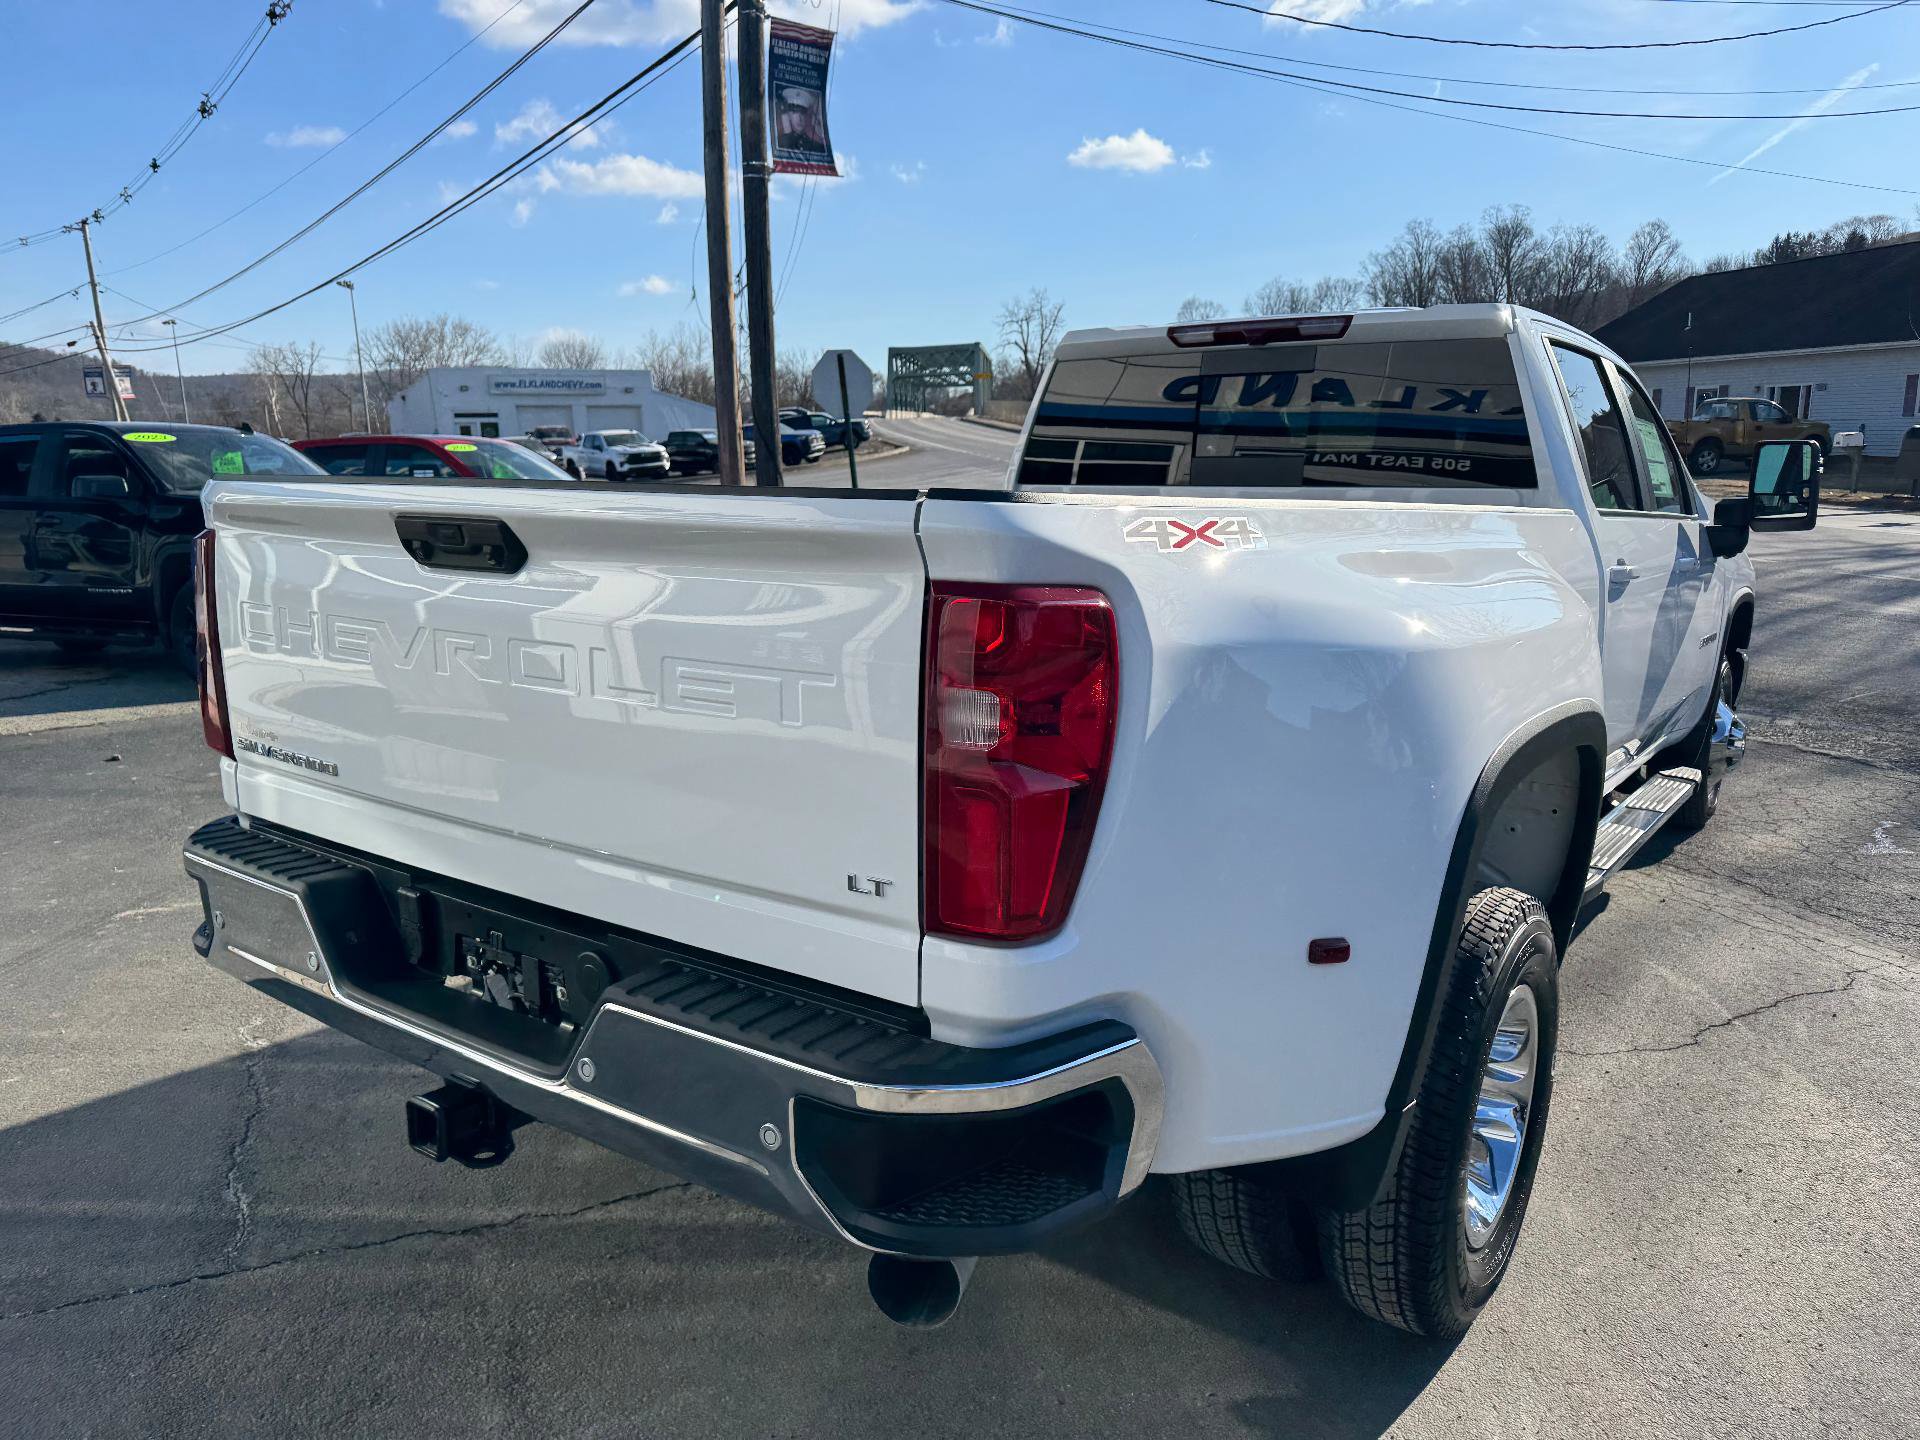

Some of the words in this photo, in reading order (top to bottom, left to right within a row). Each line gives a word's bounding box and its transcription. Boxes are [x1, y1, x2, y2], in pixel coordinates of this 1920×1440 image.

[494, 379, 602, 389] www.ELKLANDCHEVY.com
[239, 600, 837, 727] CHEVROLET
[237, 736, 339, 776] SILVERADO
[847, 873, 895, 897] LT
